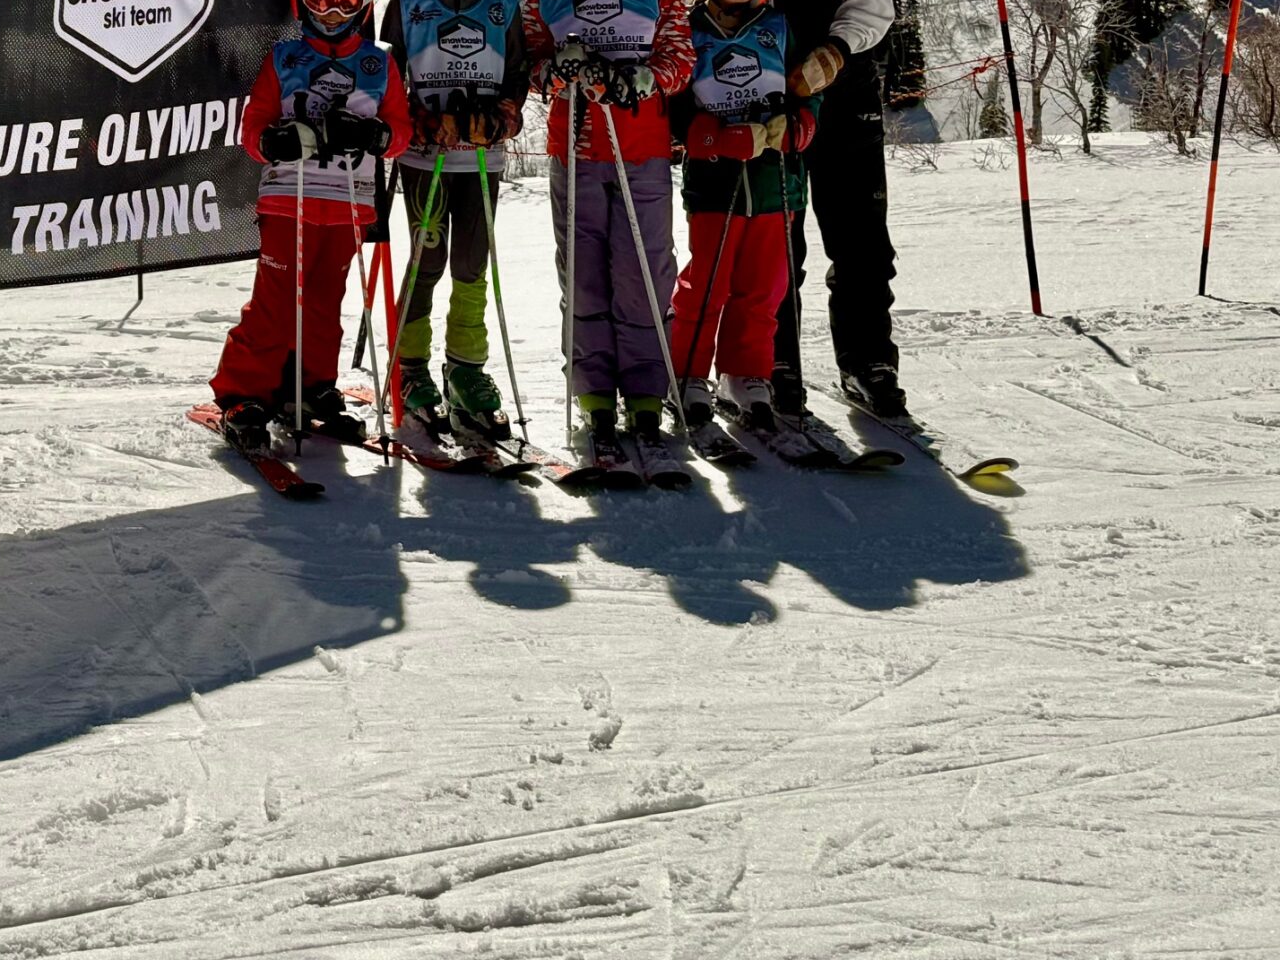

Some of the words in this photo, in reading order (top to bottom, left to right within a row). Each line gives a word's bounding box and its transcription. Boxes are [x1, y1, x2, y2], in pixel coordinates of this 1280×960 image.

[103, 7, 126, 29] ski
[130, 4, 172, 26] team
[581, 27, 616, 37] 2026
[606, 35, 645, 44] LEAGUE
[447, 61, 478, 71] 2026
[420, 71, 452, 80] YOUTH
[453, 71, 467, 79] SKI
[726, 88, 758, 101] 2026
[707, 102, 731, 110] OUTH
[96, 95, 251, 167] OLYMPI
[10, 180, 222, 255] TRAINING
